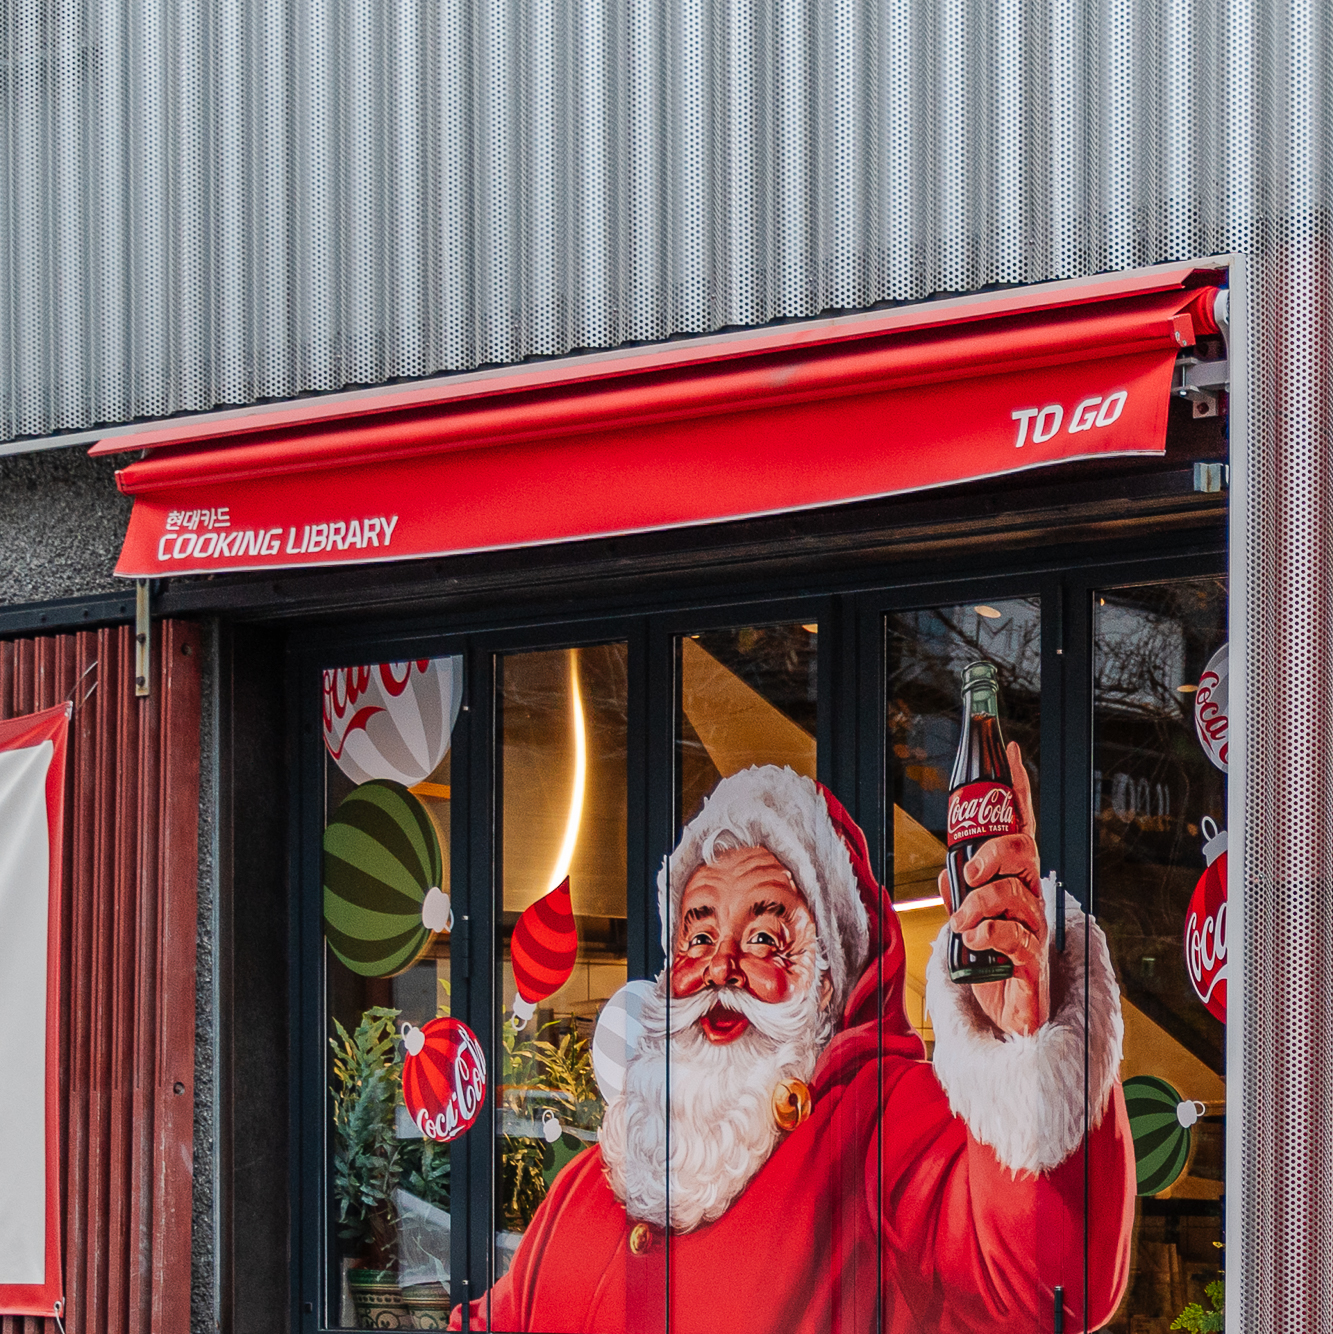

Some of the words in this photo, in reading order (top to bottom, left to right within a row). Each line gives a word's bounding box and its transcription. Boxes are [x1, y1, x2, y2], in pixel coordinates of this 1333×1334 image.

[1012, 404, 1064, 448] TO
[1068, 390, 1128, 434] GO
[158, 528, 282, 561] COOKING
[286, 515, 398, 555] LIBRARY
[166, 507, 230, 531] 현대카드
[948, 788, 1013, 834] Coca-Cola
[953, 826, 986, 840] ORIGINAL
